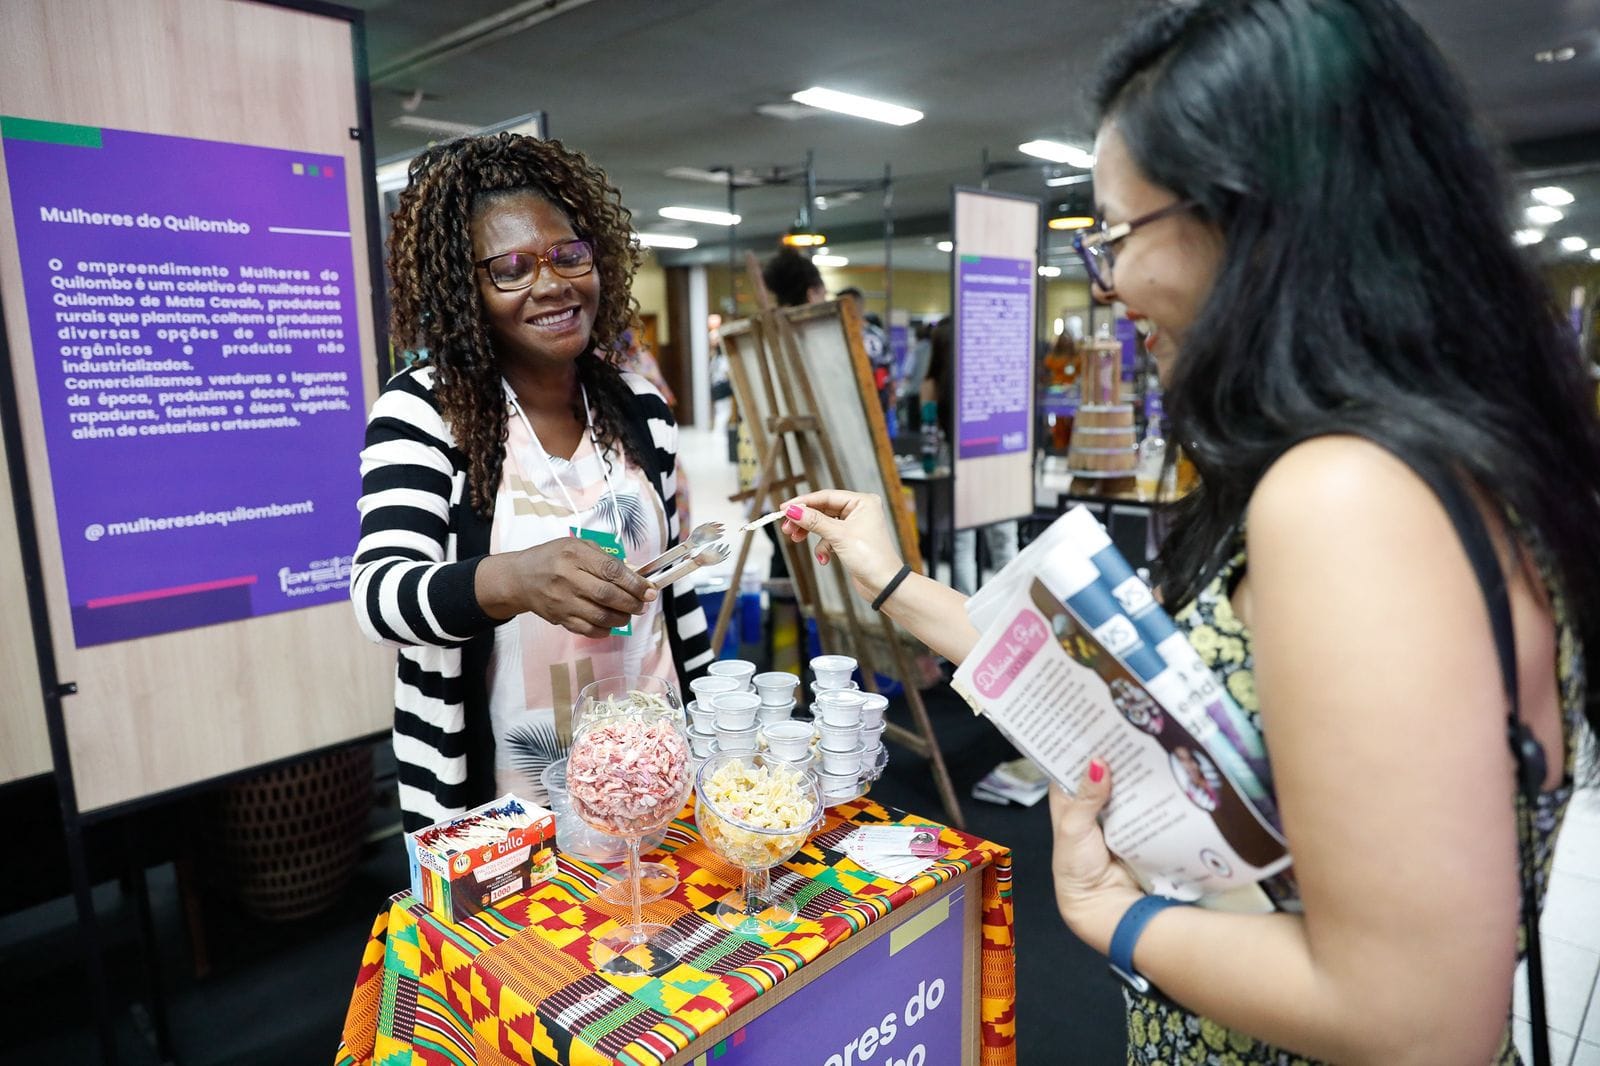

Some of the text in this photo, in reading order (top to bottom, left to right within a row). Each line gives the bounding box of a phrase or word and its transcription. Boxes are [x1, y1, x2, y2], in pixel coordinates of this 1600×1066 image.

[40, 206, 250, 235] Mulheres do Quilombo
[48, 258, 63, 271] O
[77, 261, 229, 277] empreendimento
[240, 266, 310, 280] Mulheres
[51, 275, 133, 290] Quilombo
[135, 277, 146, 291] é
[148, 280, 175, 291] um
[176, 280, 236, 293] coletivo
[237, 281, 256, 294] de
[258, 282, 321, 295] mulheres
[53, 292, 135, 307] Quilombo
[140, 294, 160, 307] de
[165, 295, 205, 308] Mata
[268, 298, 342, 312] produtoras
[56, 309, 342, 327] rurais que plantam, colhem e produzem
[57, 326, 344, 343] diversas opções de alimentos
[60, 341, 345, 359] orgânicos e produtos não
[62, 358, 194, 373] industrializados.
[64, 371, 348, 389] Comercializamos verduras e legumes
[67, 384, 349, 408] da época, produzimos doces, geleias,
[70, 397, 350, 425] rapaduras, farinhas e óleos vegetais,
[72, 416, 301, 440] além de cestarias e artesanato.
[493, 886, 511, 899] 1000
[904, 978, 945, 1027] do
